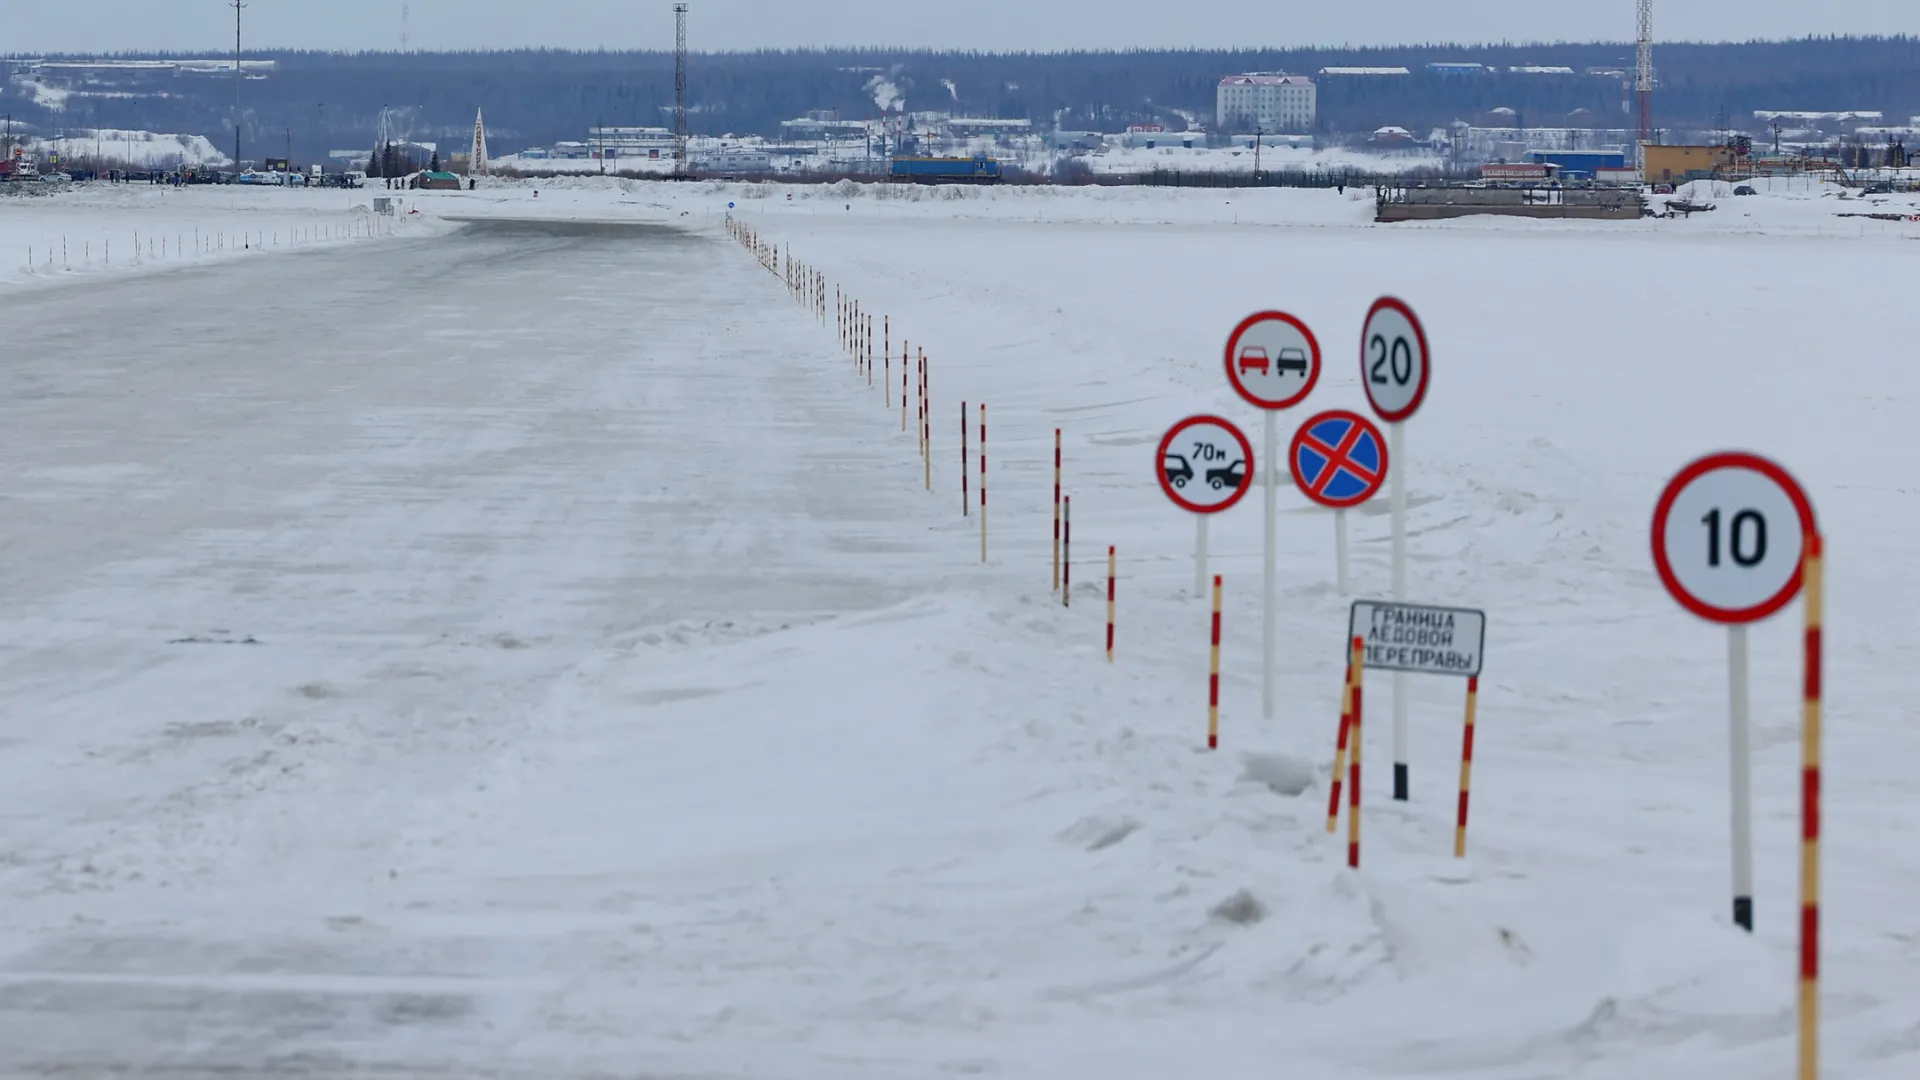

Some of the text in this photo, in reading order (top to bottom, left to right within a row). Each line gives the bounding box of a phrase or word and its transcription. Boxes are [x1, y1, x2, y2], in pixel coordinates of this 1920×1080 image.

[1371, 334, 1411, 385] 20
[1192, 442, 1226, 461] 70м
[1701, 508, 1768, 568] 10
[1372, 605, 1455, 629] ГРАНИЦА
[1369, 625, 1453, 646] ЛЕДОВОЙ
